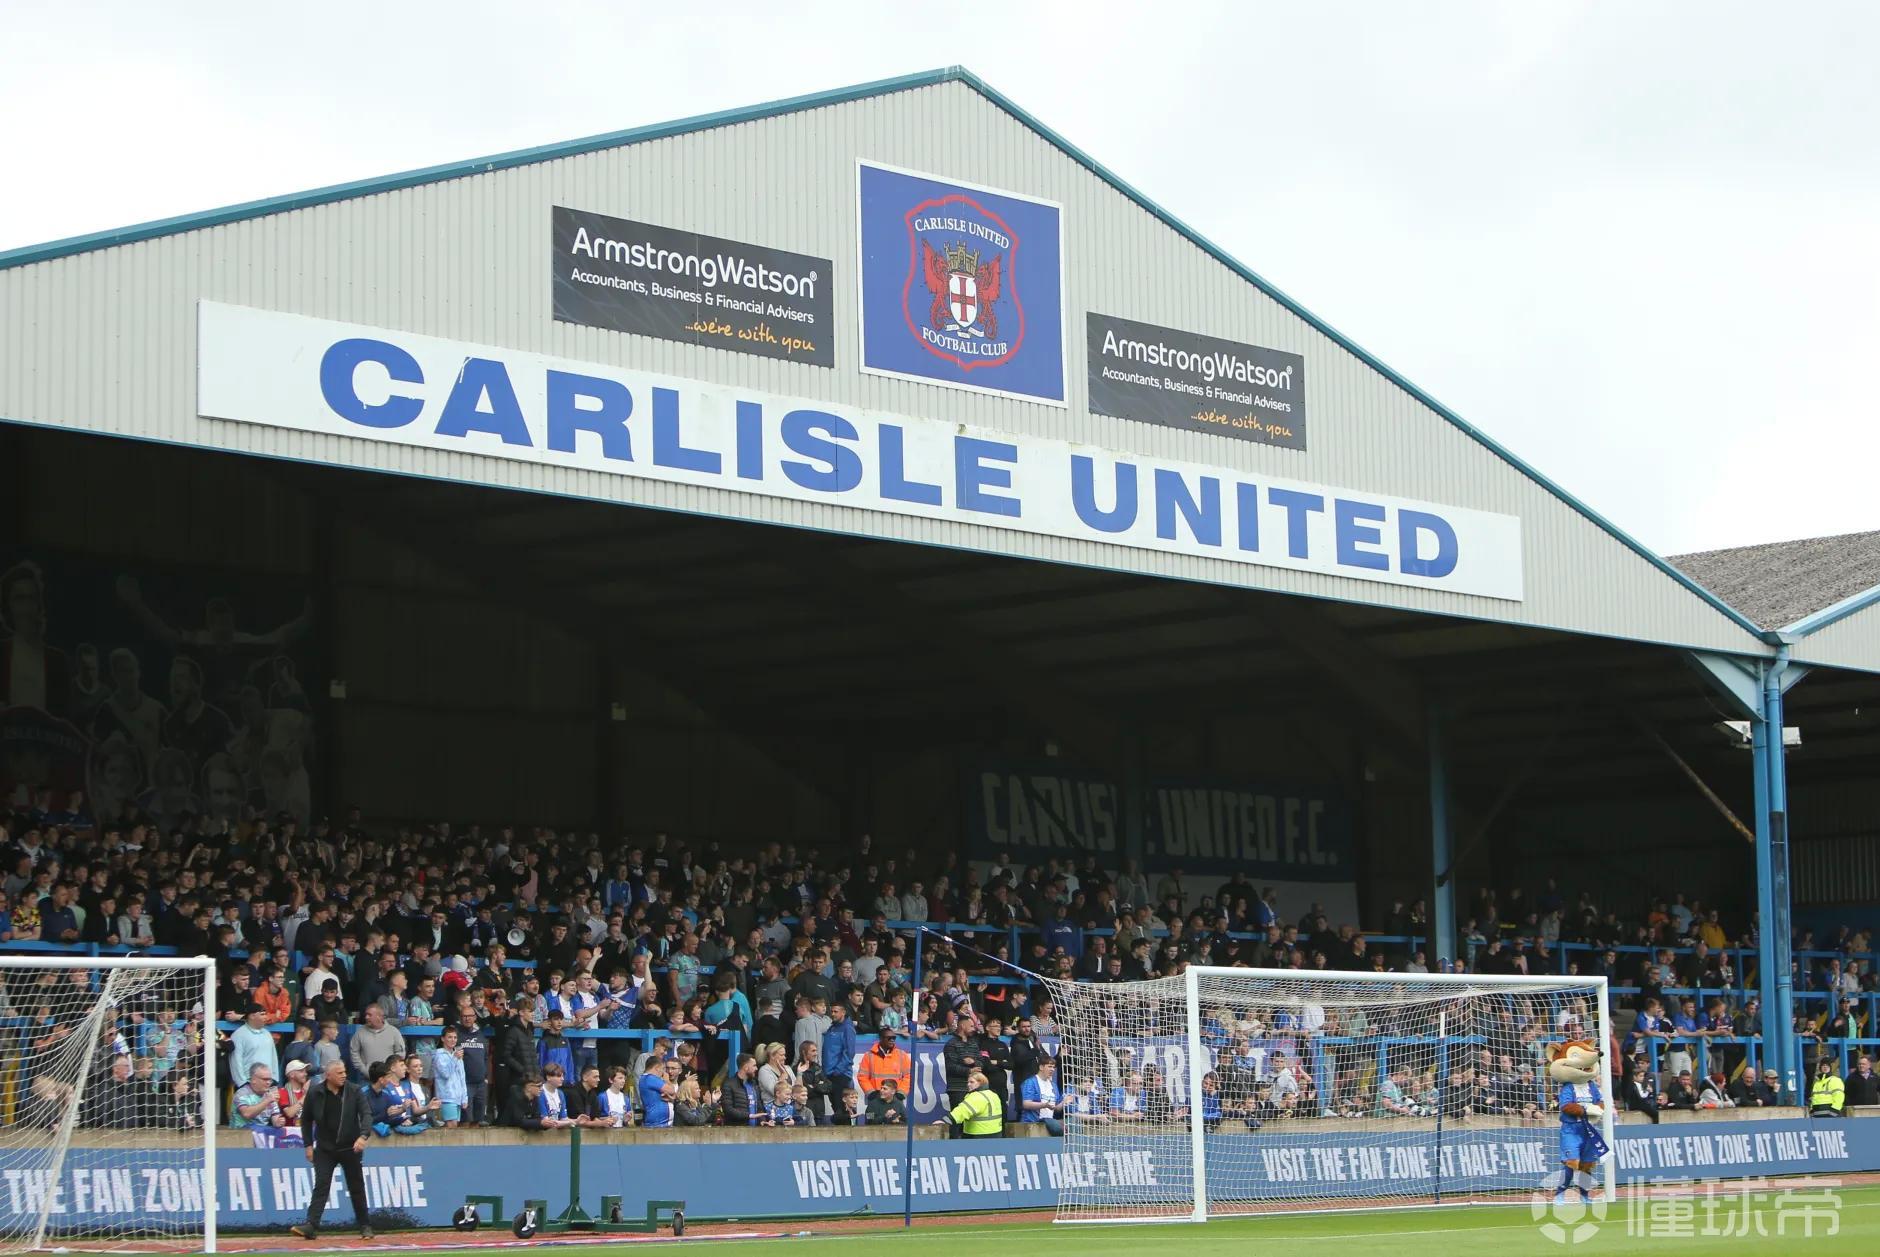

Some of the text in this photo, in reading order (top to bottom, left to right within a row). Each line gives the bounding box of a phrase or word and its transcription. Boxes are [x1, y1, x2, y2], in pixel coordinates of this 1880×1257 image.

[914, 217, 1010, 249] CARLISLE UNITED
[571, 267, 815, 324] Accountants, Business & Financial Advisers
[738, 322, 777, 344] with
[781, 335, 816, 354] you
[922, 326, 1008, 356] FOOTBALL CLUB
[1102, 366, 1292, 412] Accountants, Business & Financial Advisers
[1232, 412, 1263, 431] with
[1265, 424, 1293, 439] you
[319, 337, 1459, 579] CARLISLE UNITED
[981, 772, 1339, 866] CARLIS UNITED F.C.
[1261, 1148, 1308, 1182] VISIT
[1309, 1147, 1347, 1181] THE
[1347, 1147, 1385, 1180] FAN
[1385, 1146, 1431, 1179] ZONE
[1457, 1142, 1548, 1177] HALF-TIME
[1614, 1138, 1652, 1170] VISIT
[1653, 1137, 1685, 1168] THE
[1683, 1135, 1715, 1166] FAN
[1714, 1134, 1754, 1165] ZONE
[1754, 1133, 1774, 1162] AT
[1774, 1131, 1849, 1161] HALF-TIME
[3, 1168, 67, 1214] THE
[72, 1168, 135, 1213] FAN
[228, 1167, 263, 1211] AT
[271, 1165, 428, 1211] HAF-TIME
[791, 1159, 852, 1199] VISIT
[856, 1158, 903, 1197] THE
[953, 1155, 1012, 1193] ZONE
[1015, 1154, 1041, 1191] AT
[1044, 1150, 1157, 1189] HALF-TIME
